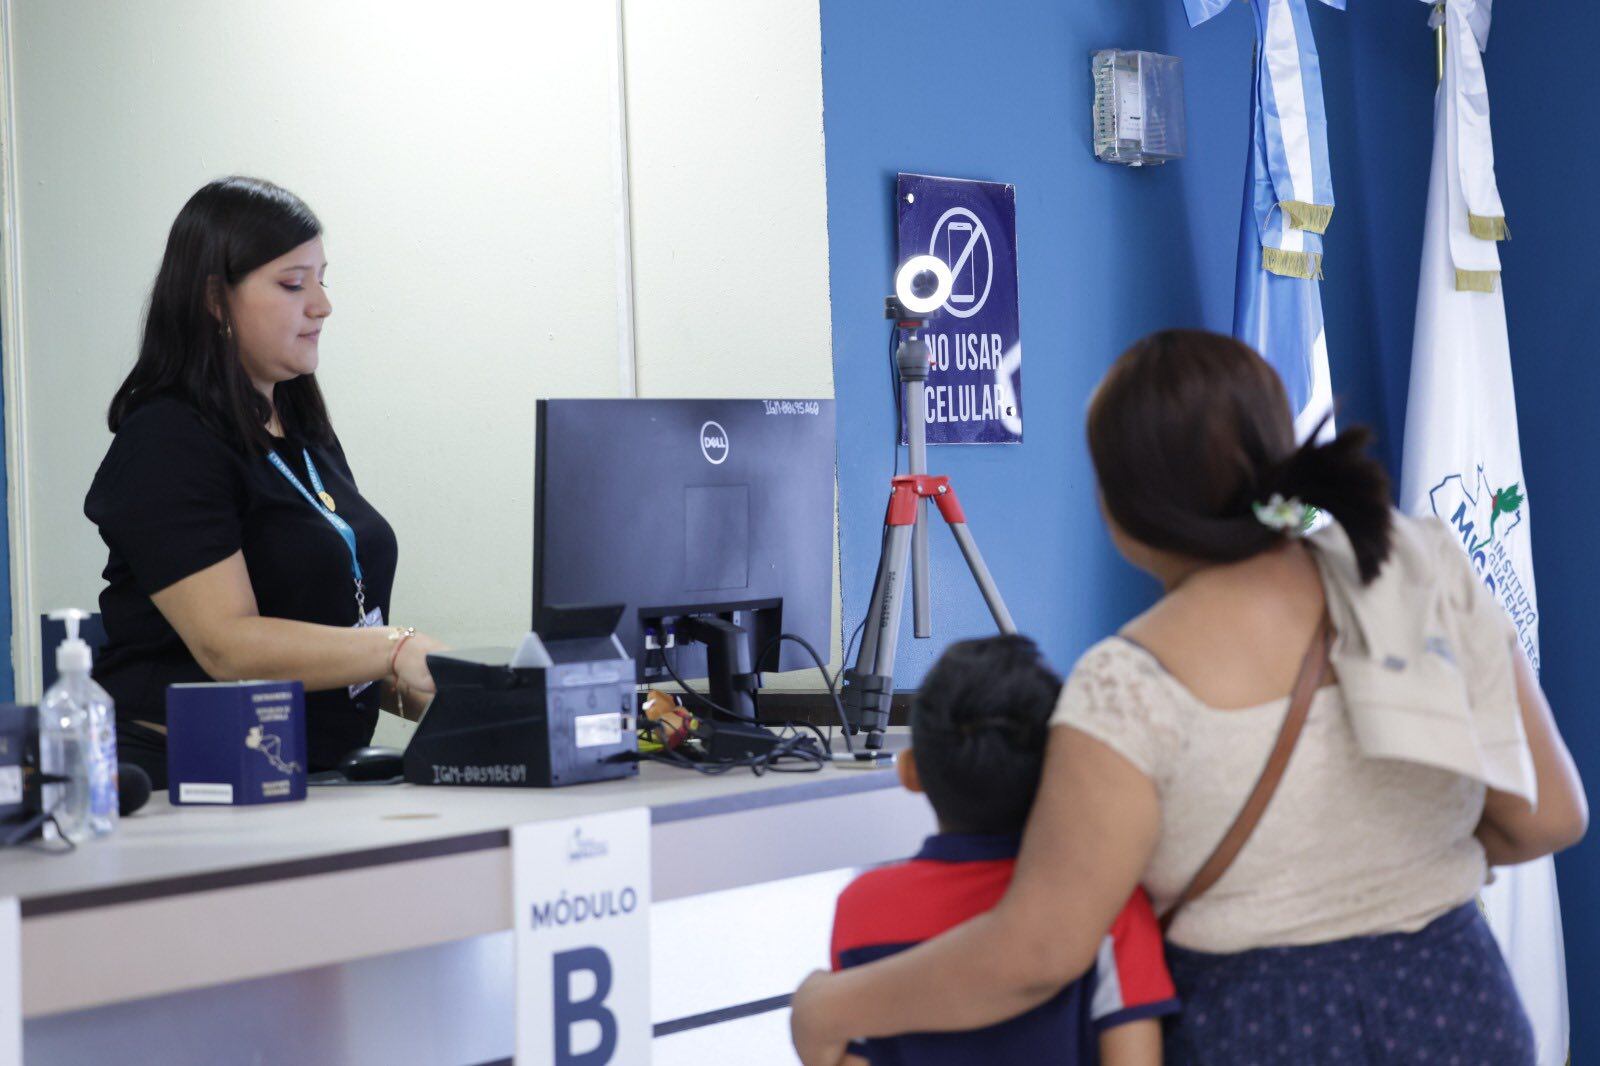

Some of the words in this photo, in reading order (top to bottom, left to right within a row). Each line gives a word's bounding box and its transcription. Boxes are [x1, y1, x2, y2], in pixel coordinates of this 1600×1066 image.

[924, 333, 950, 371] NO
[955, 333, 1003, 371] USAR
[924, 384, 1004, 423] CELULAR
[704, 437, 726, 448] DELL
[1494, 541, 1537, 626] INSTITUTO
[531, 886, 637, 929] MÓDULO
[553, 946, 618, 1066] B
